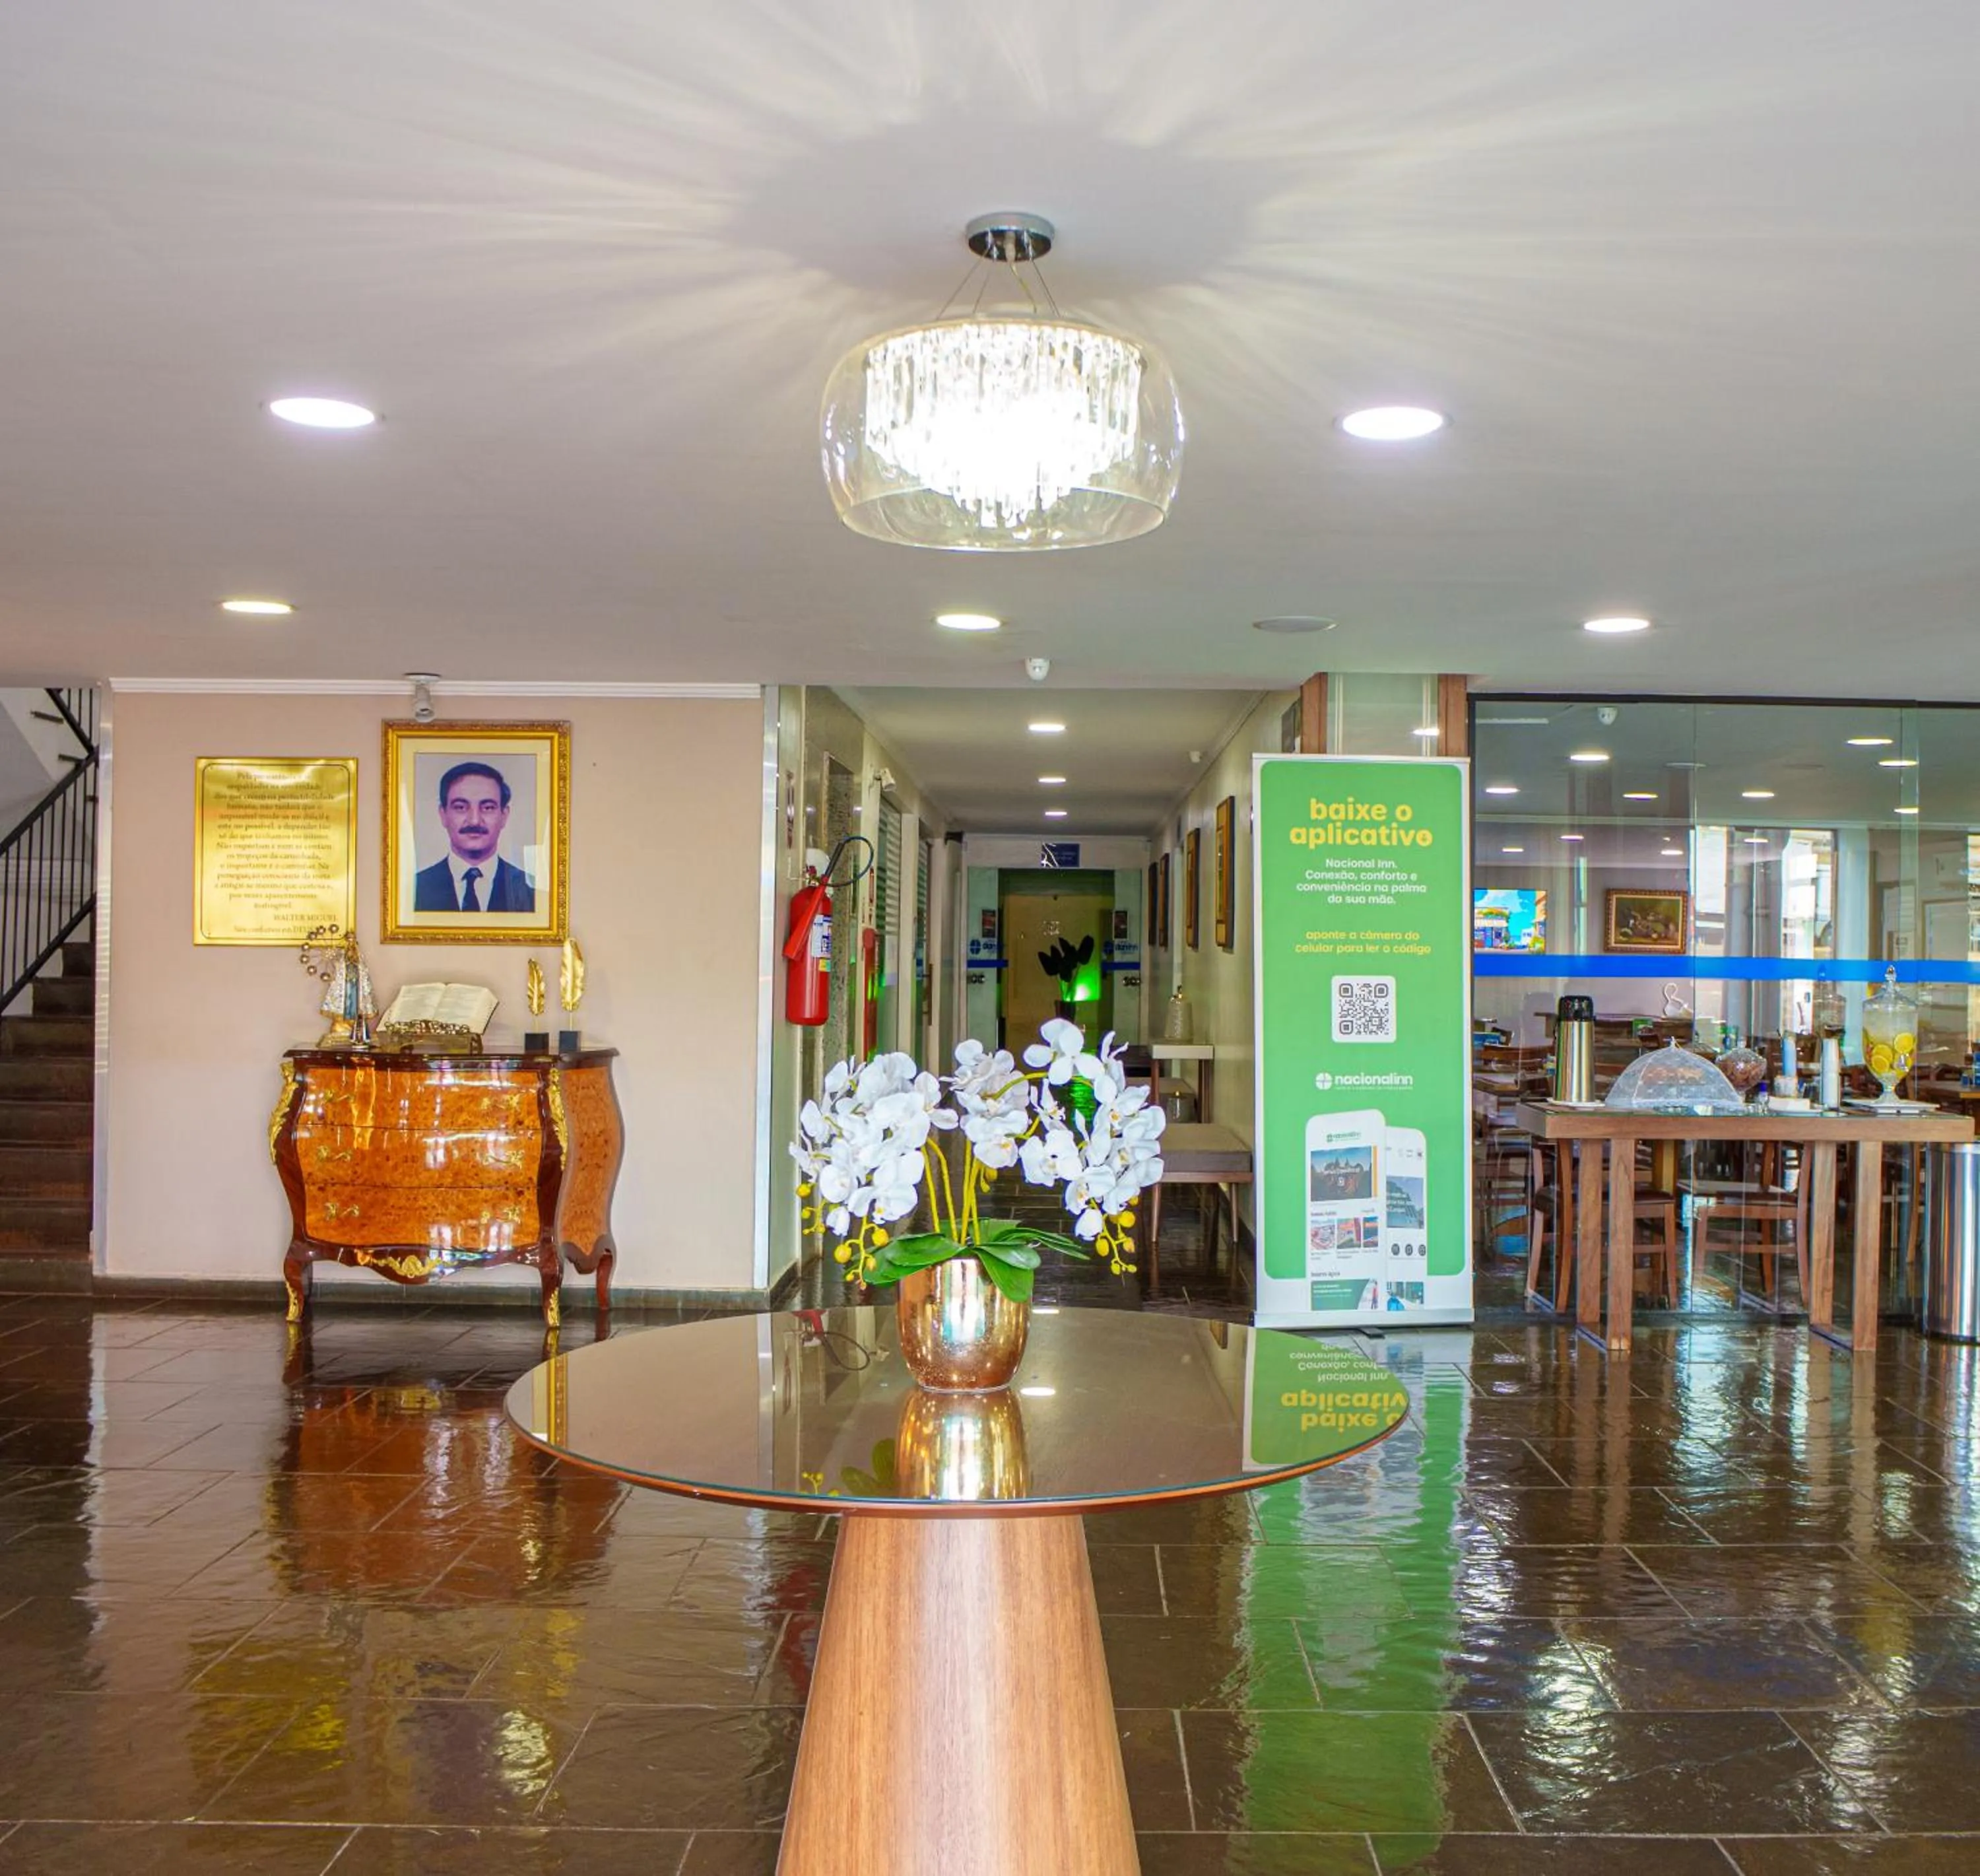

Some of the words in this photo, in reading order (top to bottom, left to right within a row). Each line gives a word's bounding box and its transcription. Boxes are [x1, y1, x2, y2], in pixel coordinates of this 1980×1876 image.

[1310, 797, 1387, 821] baixe
[1395, 805, 1412, 822] o
[1290, 822, 1434, 850] aplicativo
[1325, 858, 1375, 869] Nacional
[1377, 859, 1398, 869] Inn.
[1305, 869, 1358, 881] Conexão,
[1360, 871, 1408, 881] conforto
[1410, 872, 1418, 881] e
[1296, 882, 1371, 892] conveniência
[1373, 884, 1389, 892] na
[1391, 883, 1427, 894] palma
[1327, 894, 1343, 904] da
[1344, 896, 1366, 904] sua
[1368, 894, 1397, 905] mão.
[1305, 931, 1347, 941] aponte
[1360, 931, 1402, 941] câmera
[1404, 931, 1420, 941] do
[1296, 943, 1334, 953] celular
[1336, 945, 1364, 955] para
[1366, 944, 1379, 953] ler
[1393, 943, 1432, 955] código
[1335, 1073, 1414, 1085] nacionalinn
